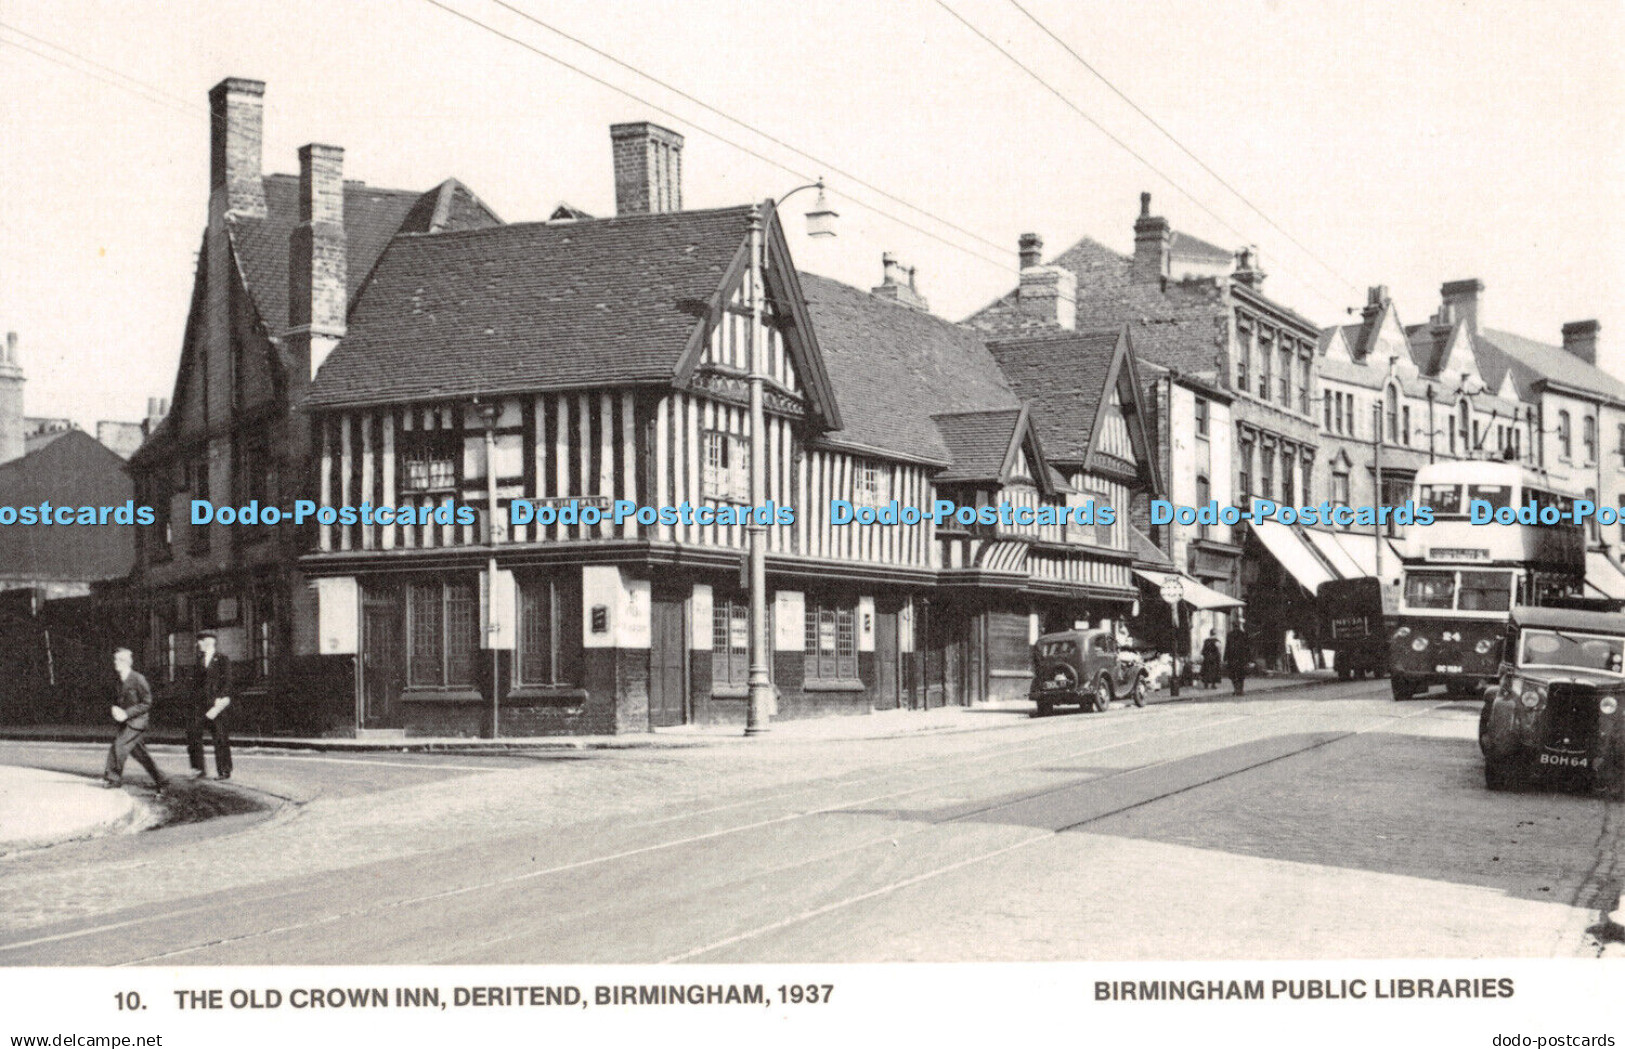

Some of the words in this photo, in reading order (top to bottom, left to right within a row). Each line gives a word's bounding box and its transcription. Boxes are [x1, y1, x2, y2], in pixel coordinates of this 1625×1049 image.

[1442, 631, 1462, 642] 24
[1540, 754, 1569, 766] BOH
[1570, 757, 1588, 768] 64
